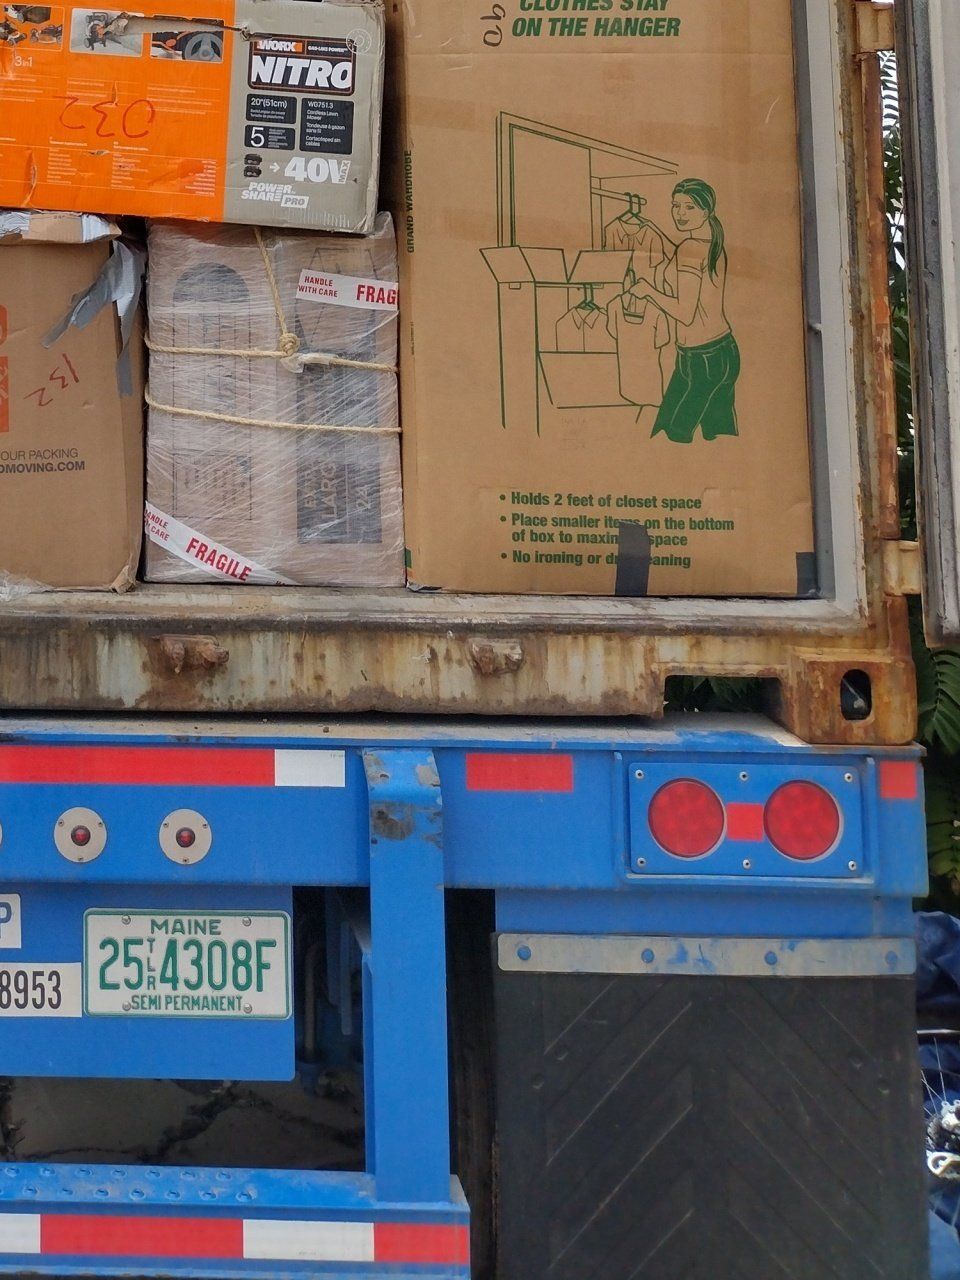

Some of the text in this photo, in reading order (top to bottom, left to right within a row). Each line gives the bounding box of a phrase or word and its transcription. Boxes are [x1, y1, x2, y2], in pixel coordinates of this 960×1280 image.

[511, 17, 681, 37] ON THE HANGER
[257, 39, 295, 52] WORX
[251, 55, 353, 89] NITRO
[250, 126, 265, 147] 5
[284, 156, 343, 184] 40V
[248, 182, 293, 194] POWER
[241, 189, 306, 206] SHARE PRO
[403, 150, 415, 254] GRAND WARDROBE
[304, 275, 333, 287] HANDLE
[298, 285, 338, 298] WITH CARE
[356, 284, 399, 306] FRAG
[28, 448, 79, 460] PACKING
[511, 491, 702, 511] Holds 2 feet of closet space
[511, 513, 549, 527] Place
[551, 515, 599, 529] smaller
[644, 519, 661, 530] on
[664, 516, 686, 530] the
[689, 517, 735, 531] bottom
[150, 526, 170, 542] CARE
[511, 529, 527, 542] of
[530, 530, 555, 543] box
[559, 531, 573, 543] to
[186, 537, 252, 582] FRAGILE
[512, 550, 603, 566] No ironing or
[150, 918, 222, 936] MAINE
[98, 937, 144, 991] 25
[158, 938, 277, 993] 4308F
[130, 994, 244, 1012] SEMI PERMANENT
